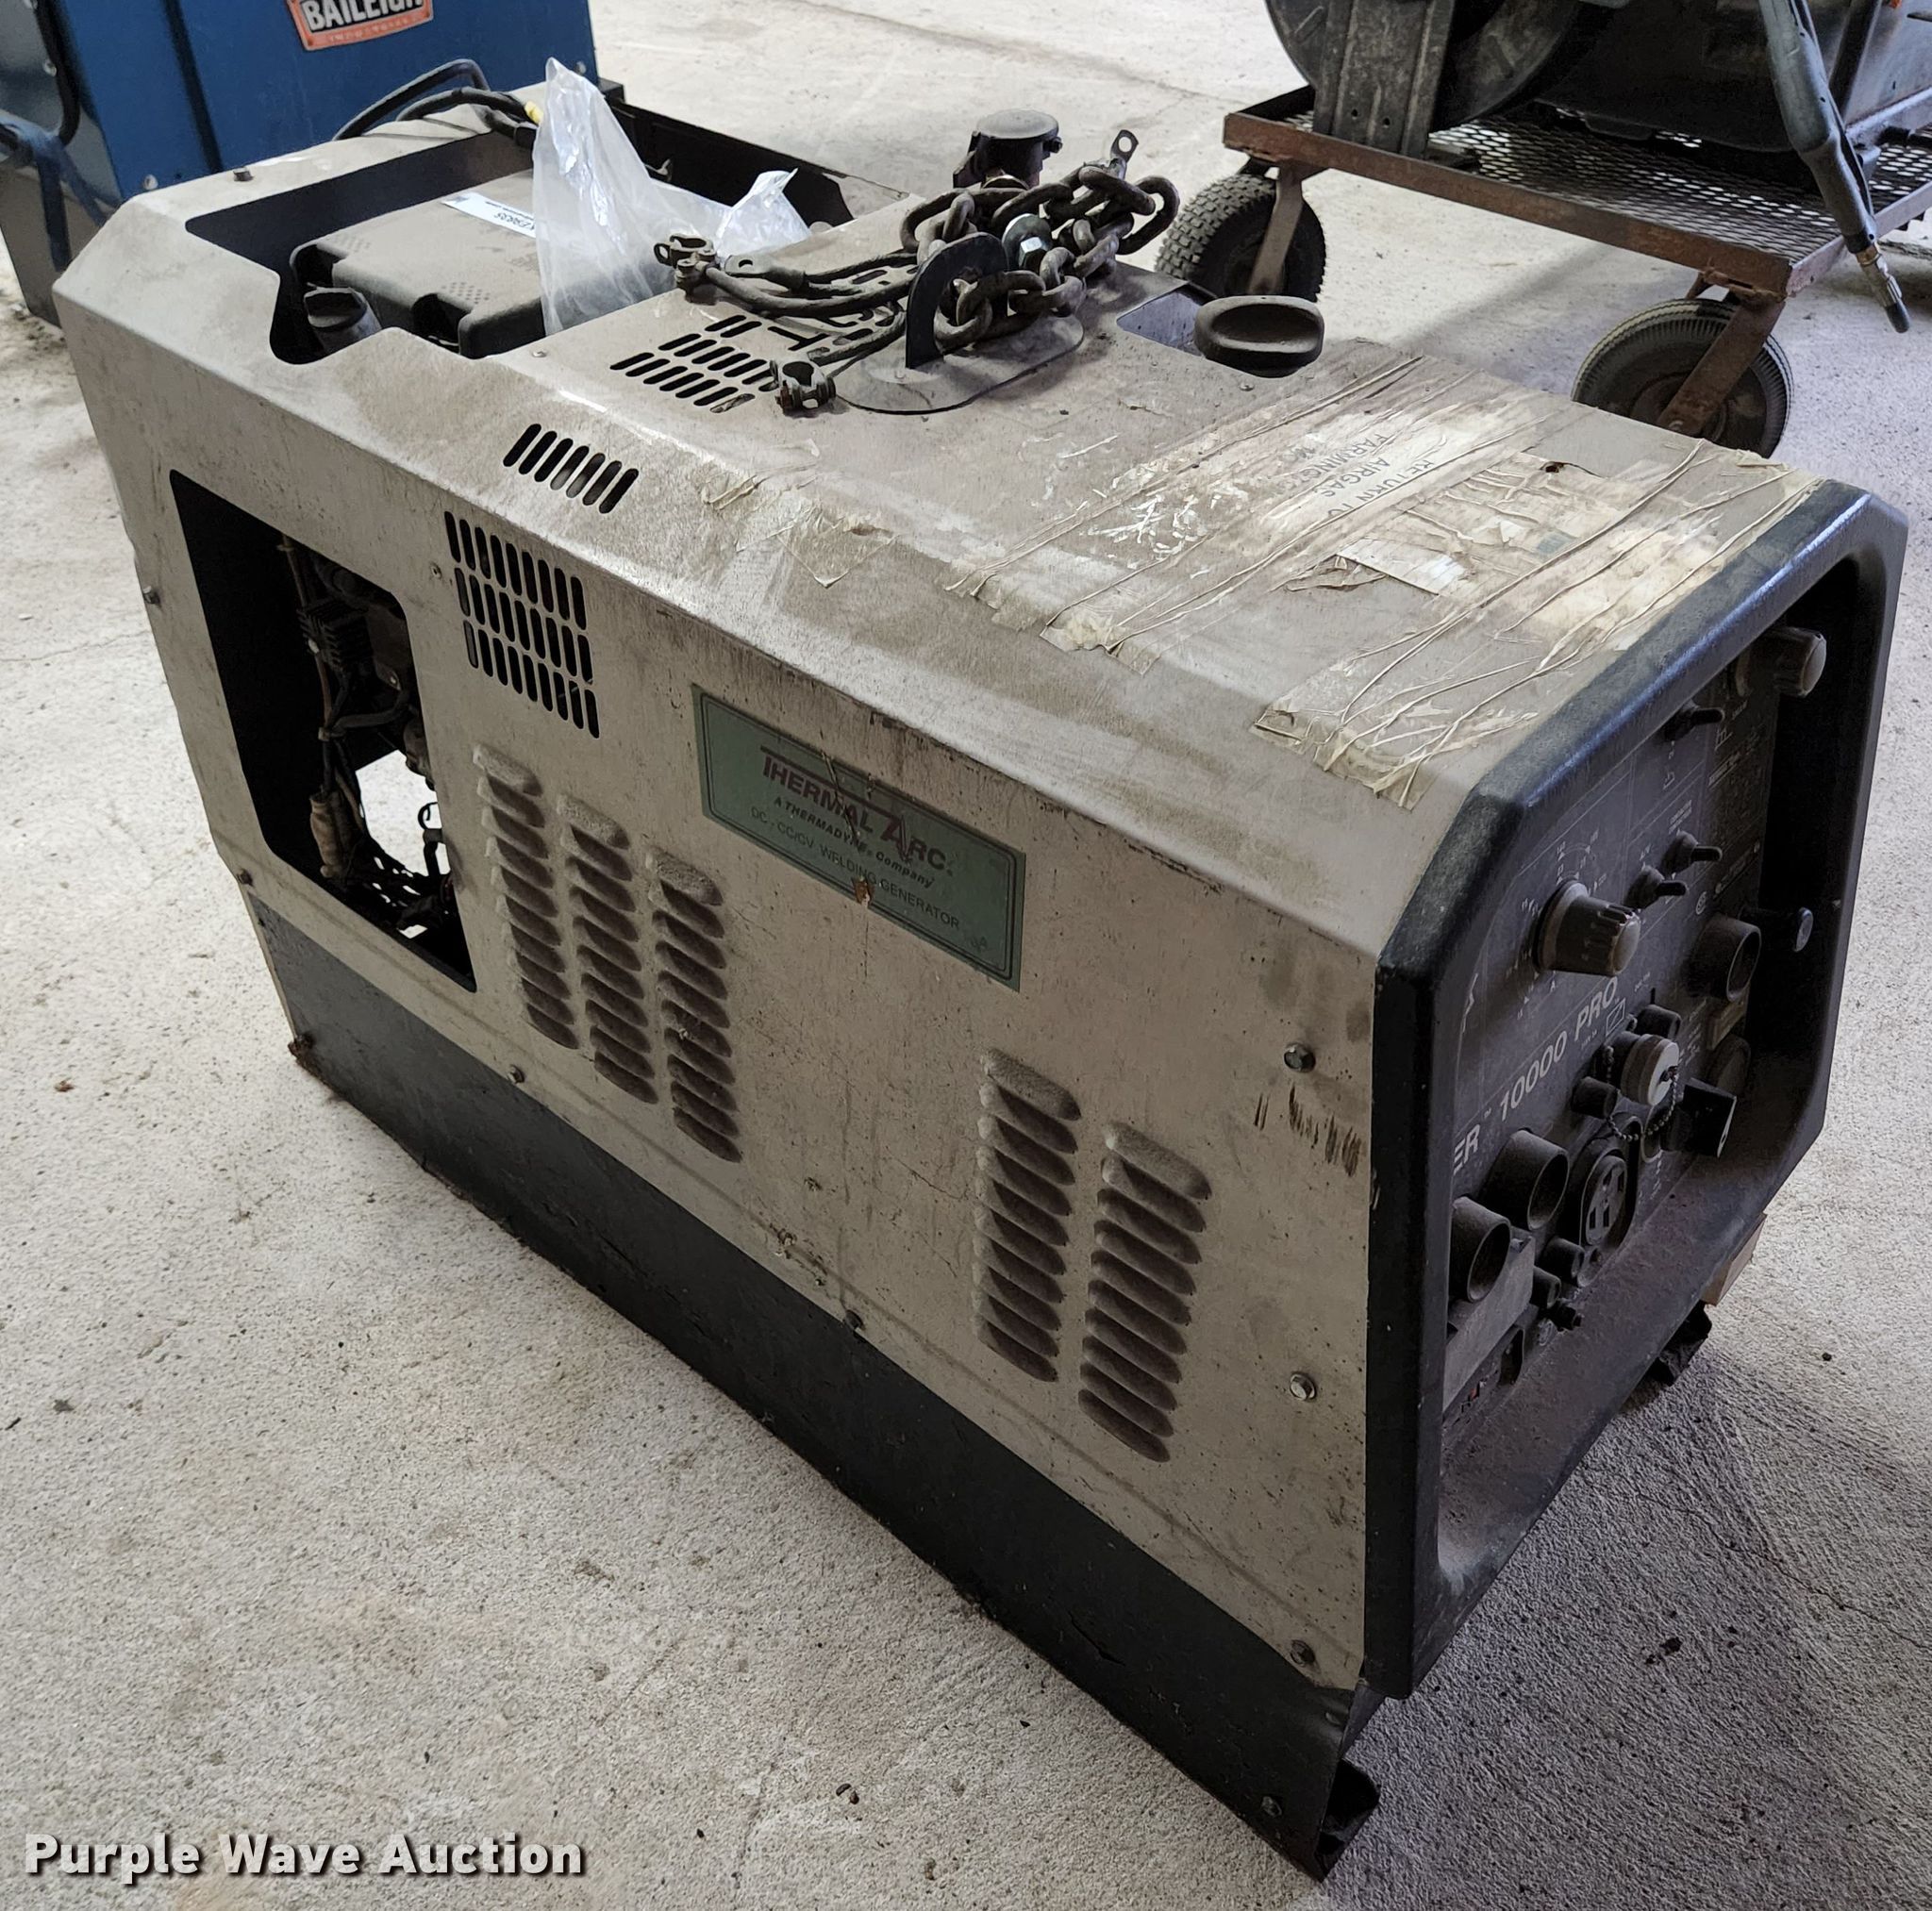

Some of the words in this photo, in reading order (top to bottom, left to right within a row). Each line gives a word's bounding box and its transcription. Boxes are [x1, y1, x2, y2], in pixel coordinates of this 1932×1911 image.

[760, 744, 874, 833] THERMAL
[875, 851, 935, 889] Company
[880, 877, 960, 929] GENERATOR
[1500, 1030, 1568, 1122] 10000
[1574, 975, 1618, 1041] PRO
